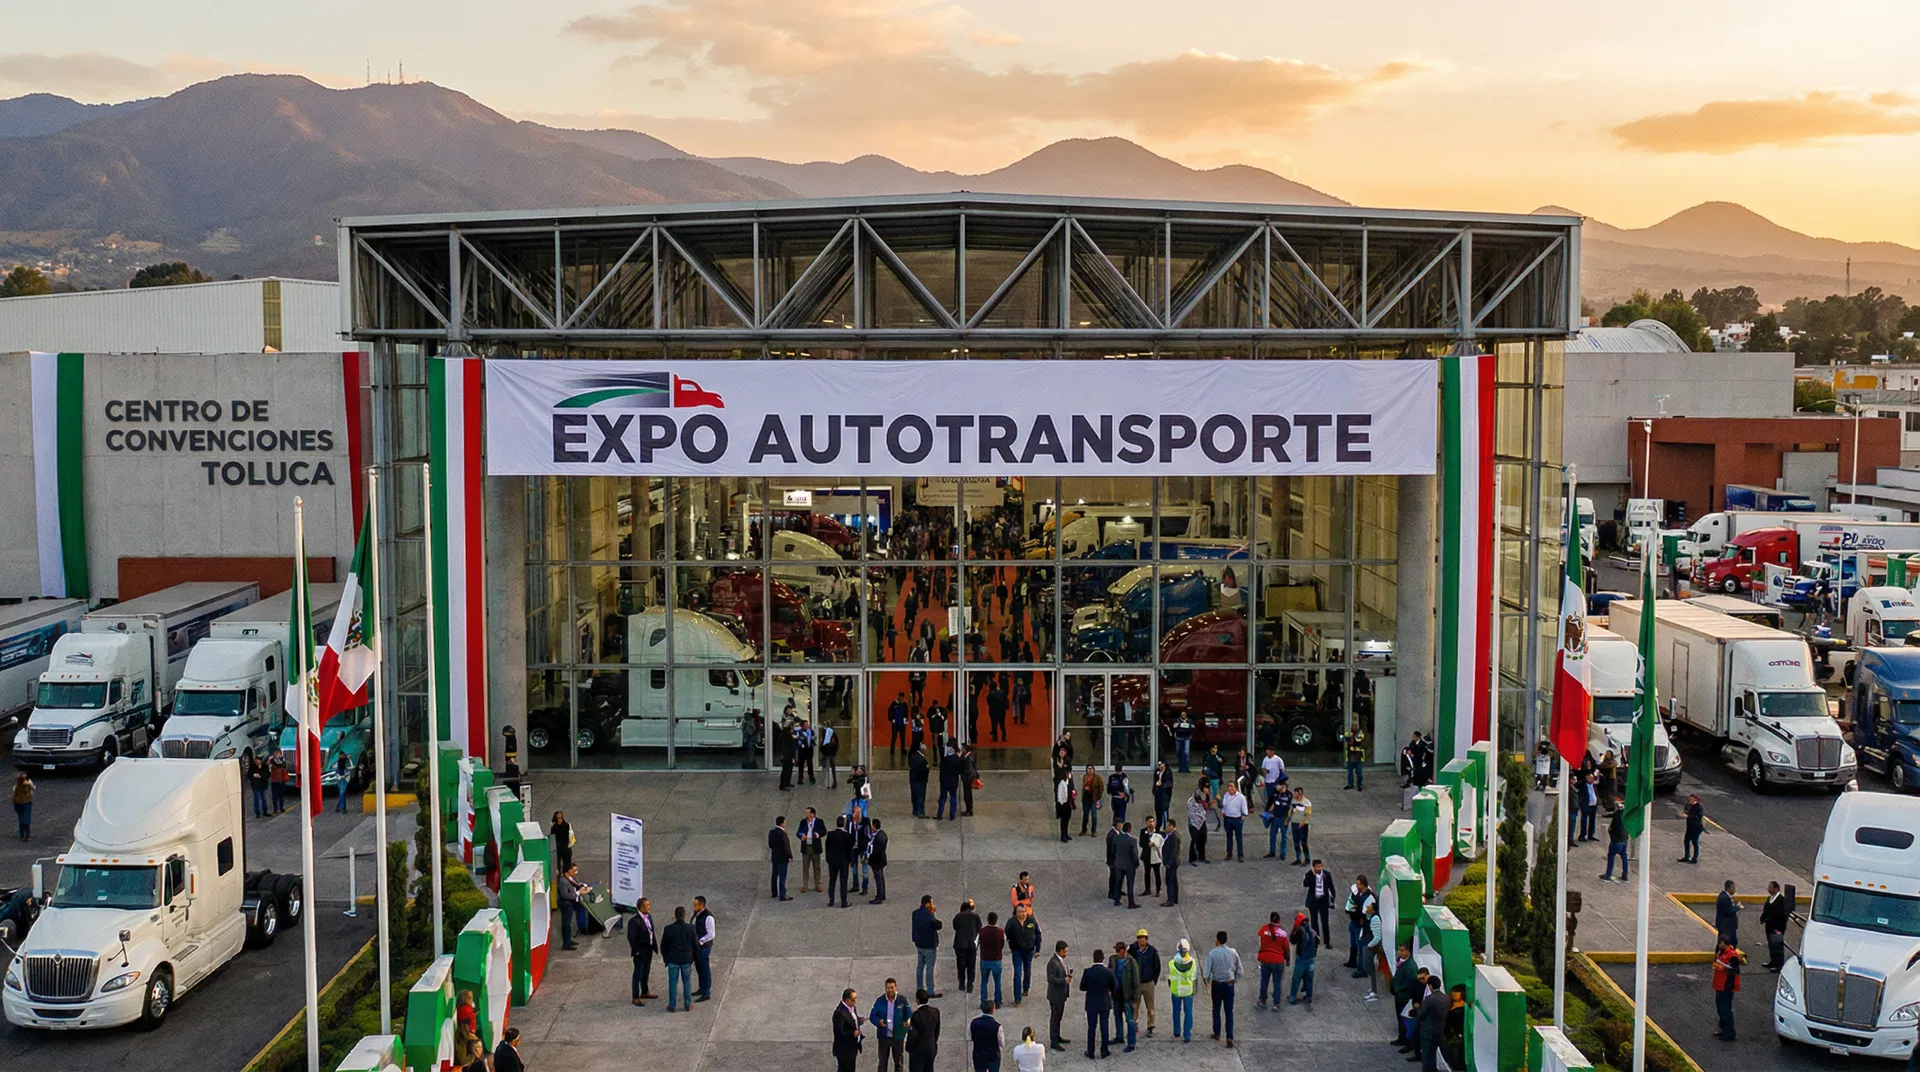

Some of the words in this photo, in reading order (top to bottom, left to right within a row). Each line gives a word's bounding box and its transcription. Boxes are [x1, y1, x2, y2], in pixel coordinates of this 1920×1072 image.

[105, 400, 222, 422] CENTRO
[232, 400, 269, 422] DE
[105, 429, 334, 452] CONVENCIONES
[553, 413, 728, 465] EXPO
[749, 413, 1372, 465] AUTOTRANSPORTE
[201, 461, 335, 486] TOLUCA
